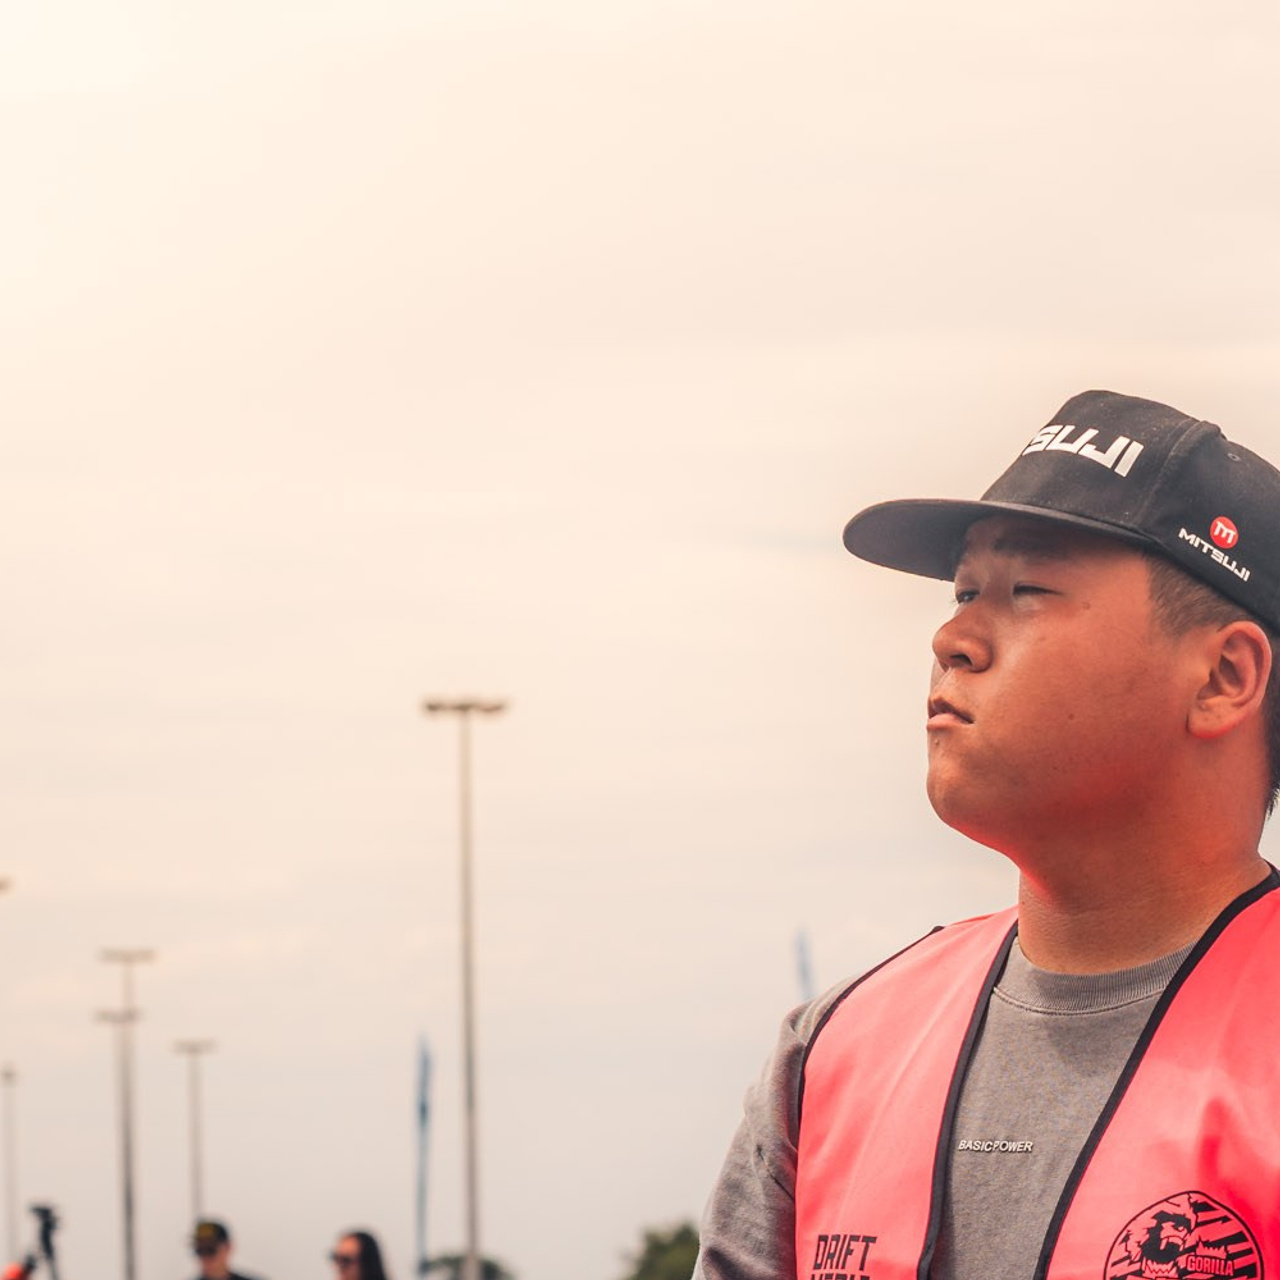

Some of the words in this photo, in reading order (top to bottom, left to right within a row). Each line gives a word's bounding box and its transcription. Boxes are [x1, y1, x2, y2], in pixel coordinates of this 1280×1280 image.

[1178, 528, 1251, 582] MITSUJI
[958, 1139, 1033, 1152] BASICPOWER
[813, 1234, 878, 1271] DRIFT
[1186, 1255, 1234, 1277] GORILLA
